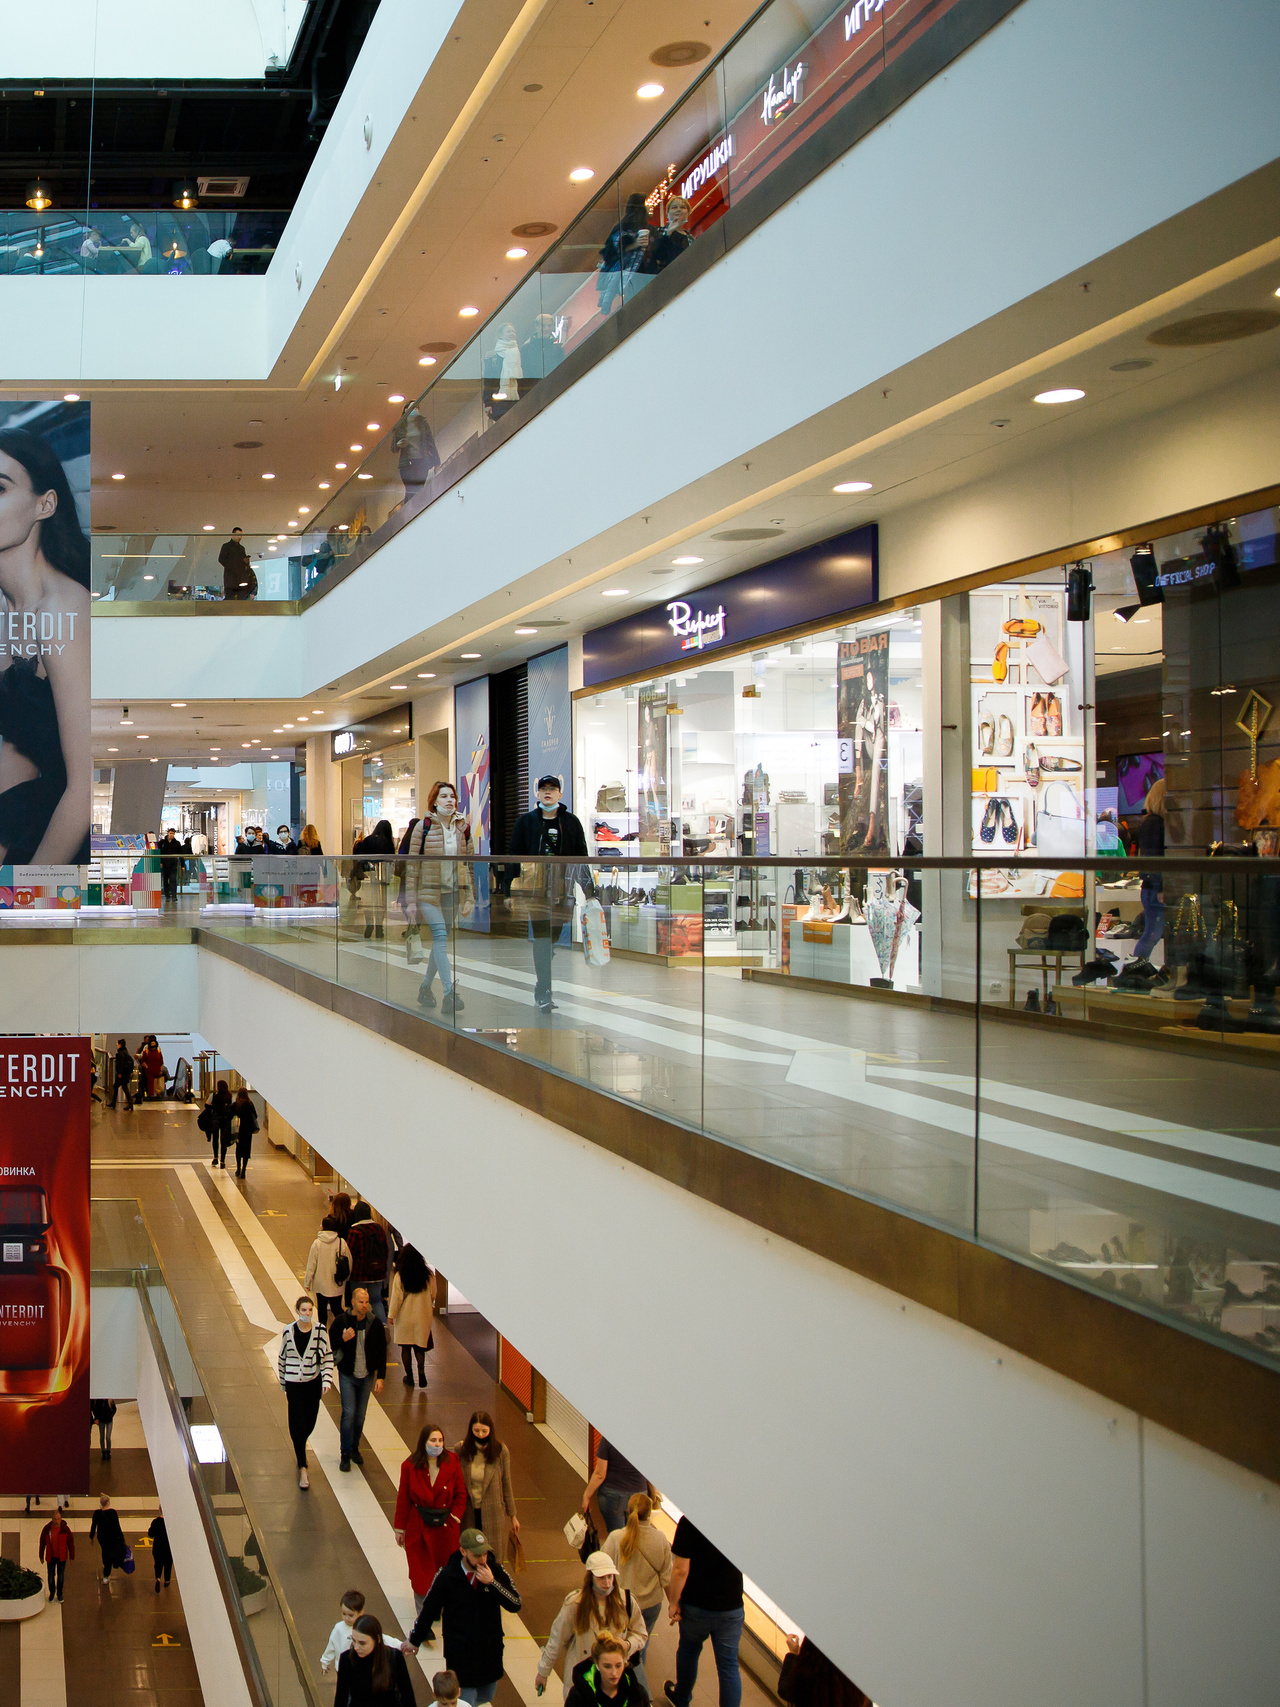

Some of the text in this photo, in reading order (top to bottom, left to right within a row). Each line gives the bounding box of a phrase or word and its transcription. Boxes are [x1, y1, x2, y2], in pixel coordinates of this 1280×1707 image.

[760, 61, 804, 126] Hamleys
[681, 134, 733, 199] ИГРУШКИ
[1195, 562, 1216, 579] SHOP
[666, 601, 728, 650] Respect
[839, 632, 889, 659] НОВАЯ
